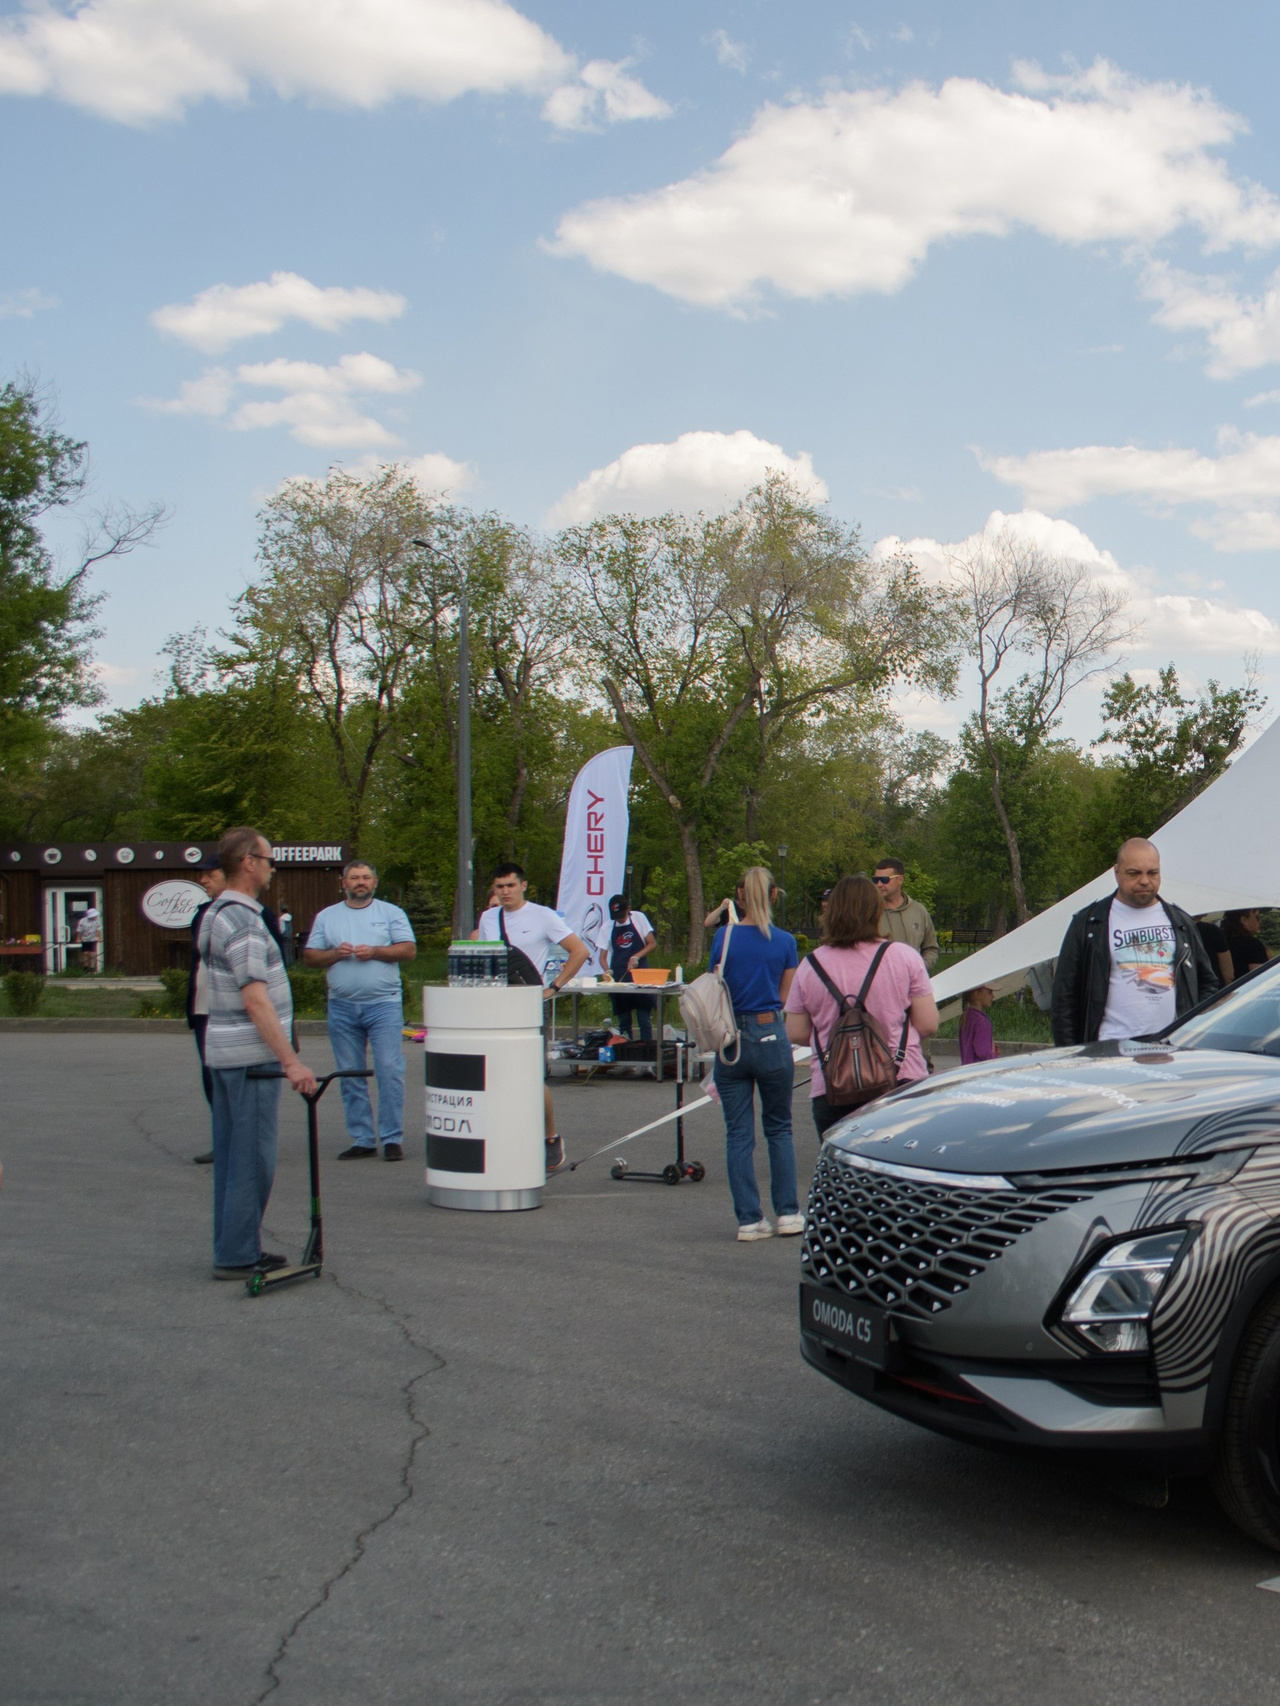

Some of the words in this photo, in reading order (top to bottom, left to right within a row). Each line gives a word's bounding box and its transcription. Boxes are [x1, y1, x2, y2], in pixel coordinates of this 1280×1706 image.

[272, 846, 342, 861] OFFEEPARK
[586, 789, 605, 896] CHERY
[427, 1093, 473, 1108] СТРАЦИЯ
[848, 1123, 948, 1155] OMODA
[812, 1298, 855, 1337] OMODA
[857, 1316, 872, 1343] C5
